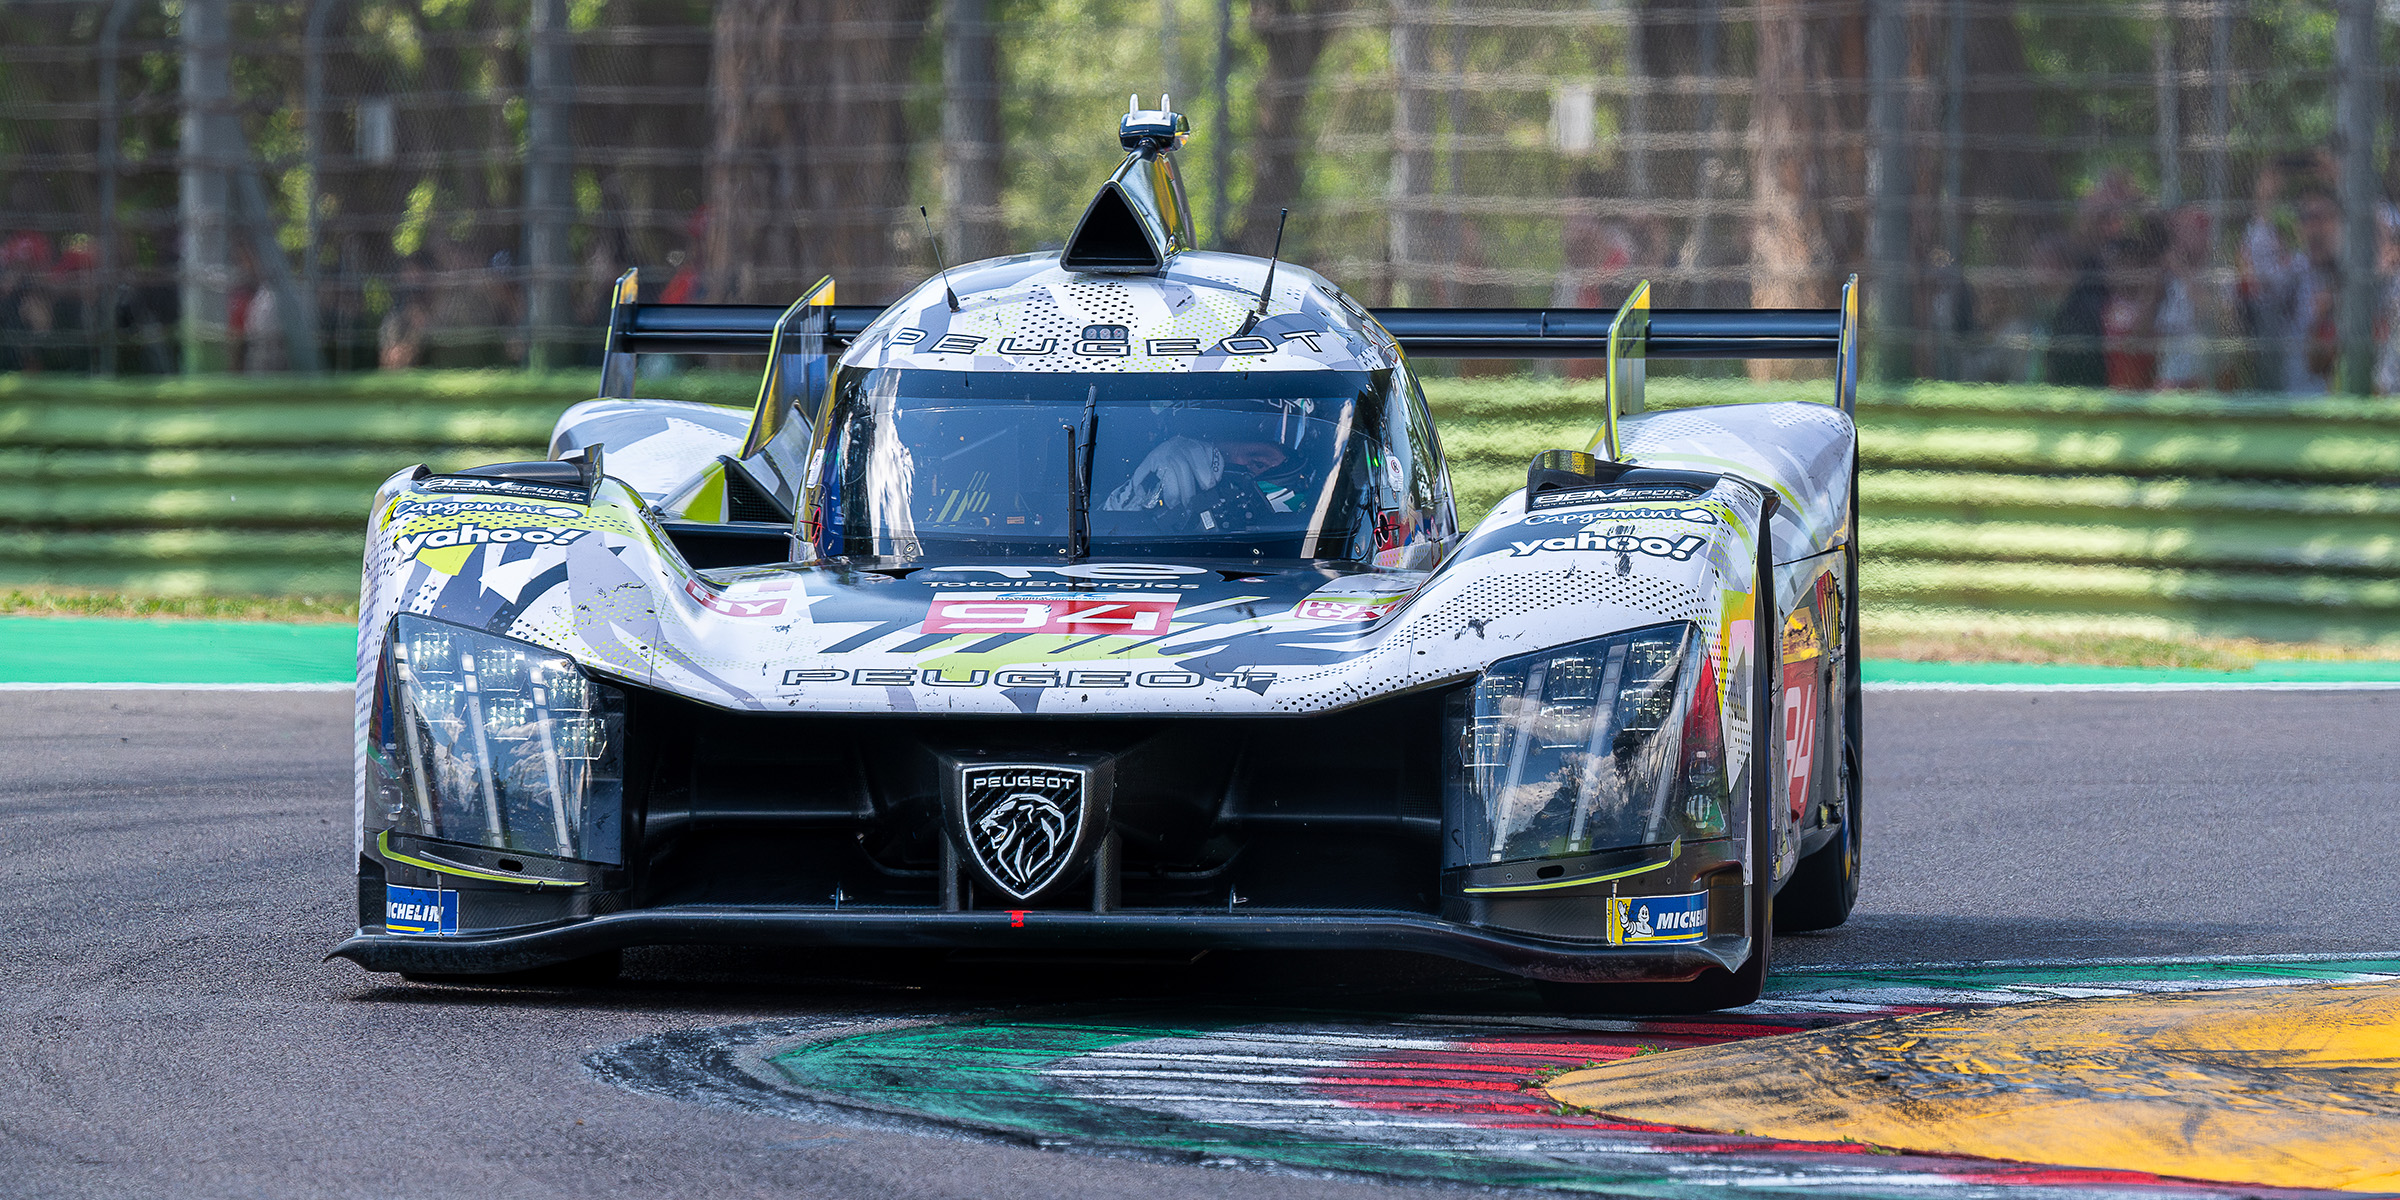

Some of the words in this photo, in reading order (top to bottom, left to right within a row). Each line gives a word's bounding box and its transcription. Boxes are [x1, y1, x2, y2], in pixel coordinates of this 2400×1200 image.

[884, 327, 1323, 357] PEUGEOT
[394, 502, 542, 518] Capgemini
[1525, 508, 1679, 525] Capgemini
[397, 524, 589, 566] yahoo!
[1511, 532, 1703, 561] yahoo!
[922, 580, 1200, 589] TotalEnergies
[938, 603, 1161, 631] 94
[782, 669, 1278, 688] PEUGEOT
[1785, 684, 1814, 803] 94
[973, 776, 1075, 790] PEUGEOT
[386, 901, 445, 922] ICHELIN
